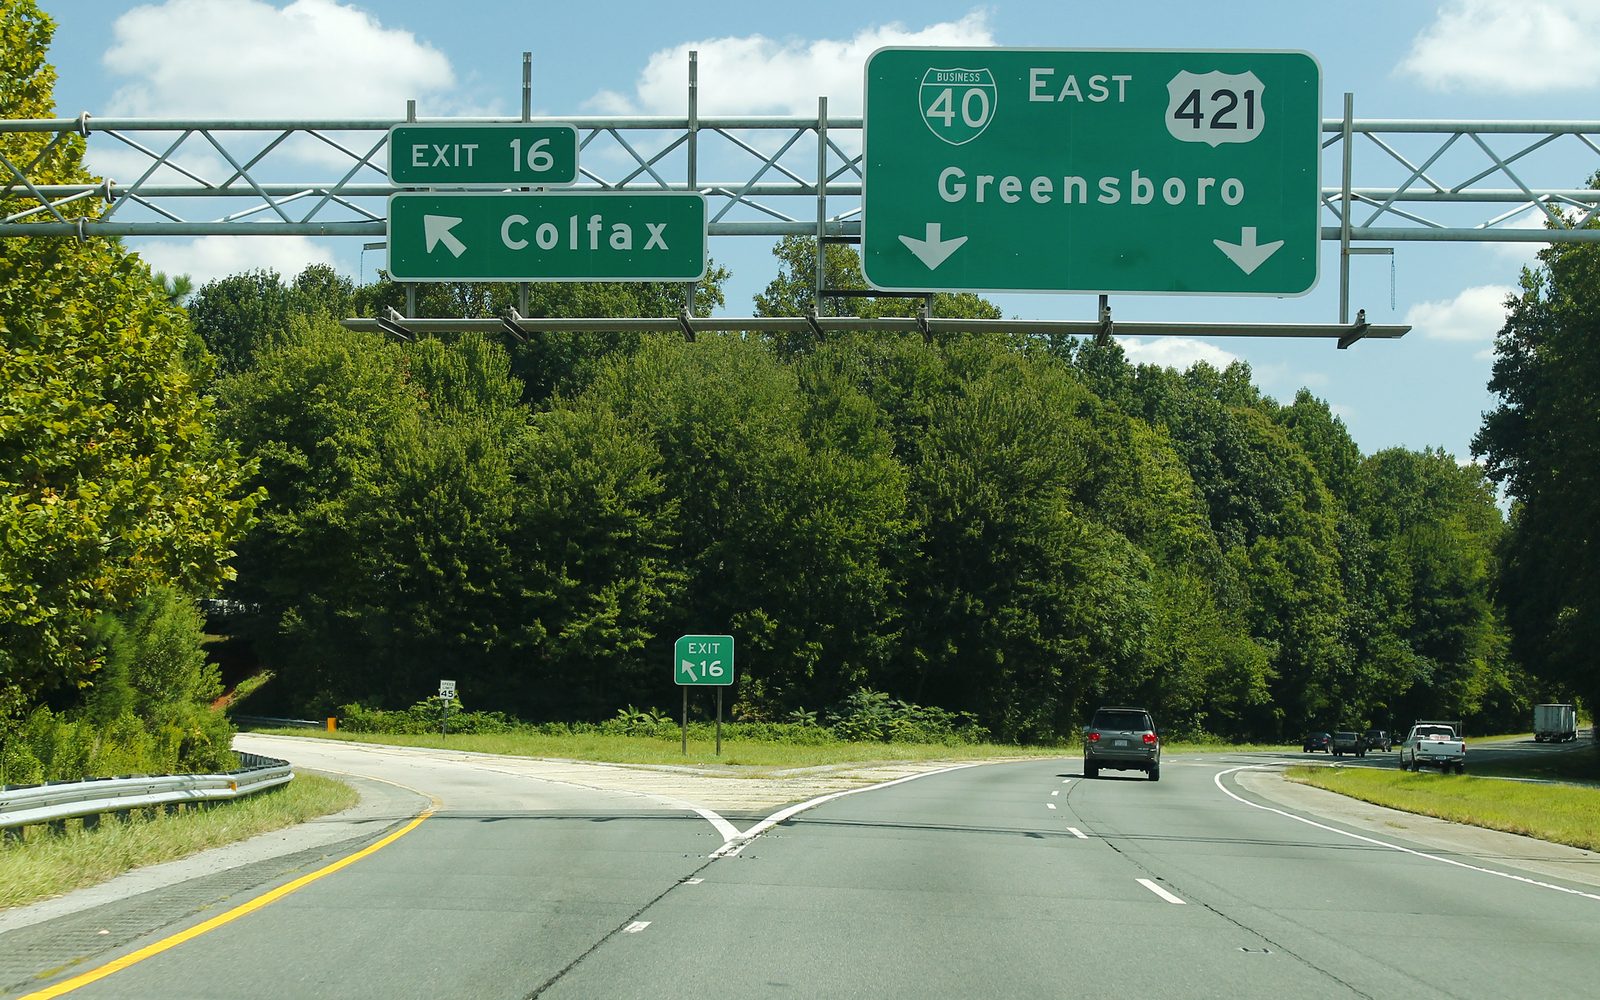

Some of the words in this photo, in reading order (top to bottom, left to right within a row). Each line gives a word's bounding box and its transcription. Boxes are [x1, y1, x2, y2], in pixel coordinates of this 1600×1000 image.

[936, 72, 981, 82] BUSINESS
[1029, 67, 1132, 103] EAST
[926, 87, 990, 128] 40
[1174, 88, 1256, 130] 421
[412, 144, 479, 167] EXIT
[510, 138, 554, 172] 16
[938, 166, 1245, 206] Greensboro
[500, 214, 669, 250] Colfax
[688, 643, 720, 654] EXIT
[700, 660, 724, 676] 16
